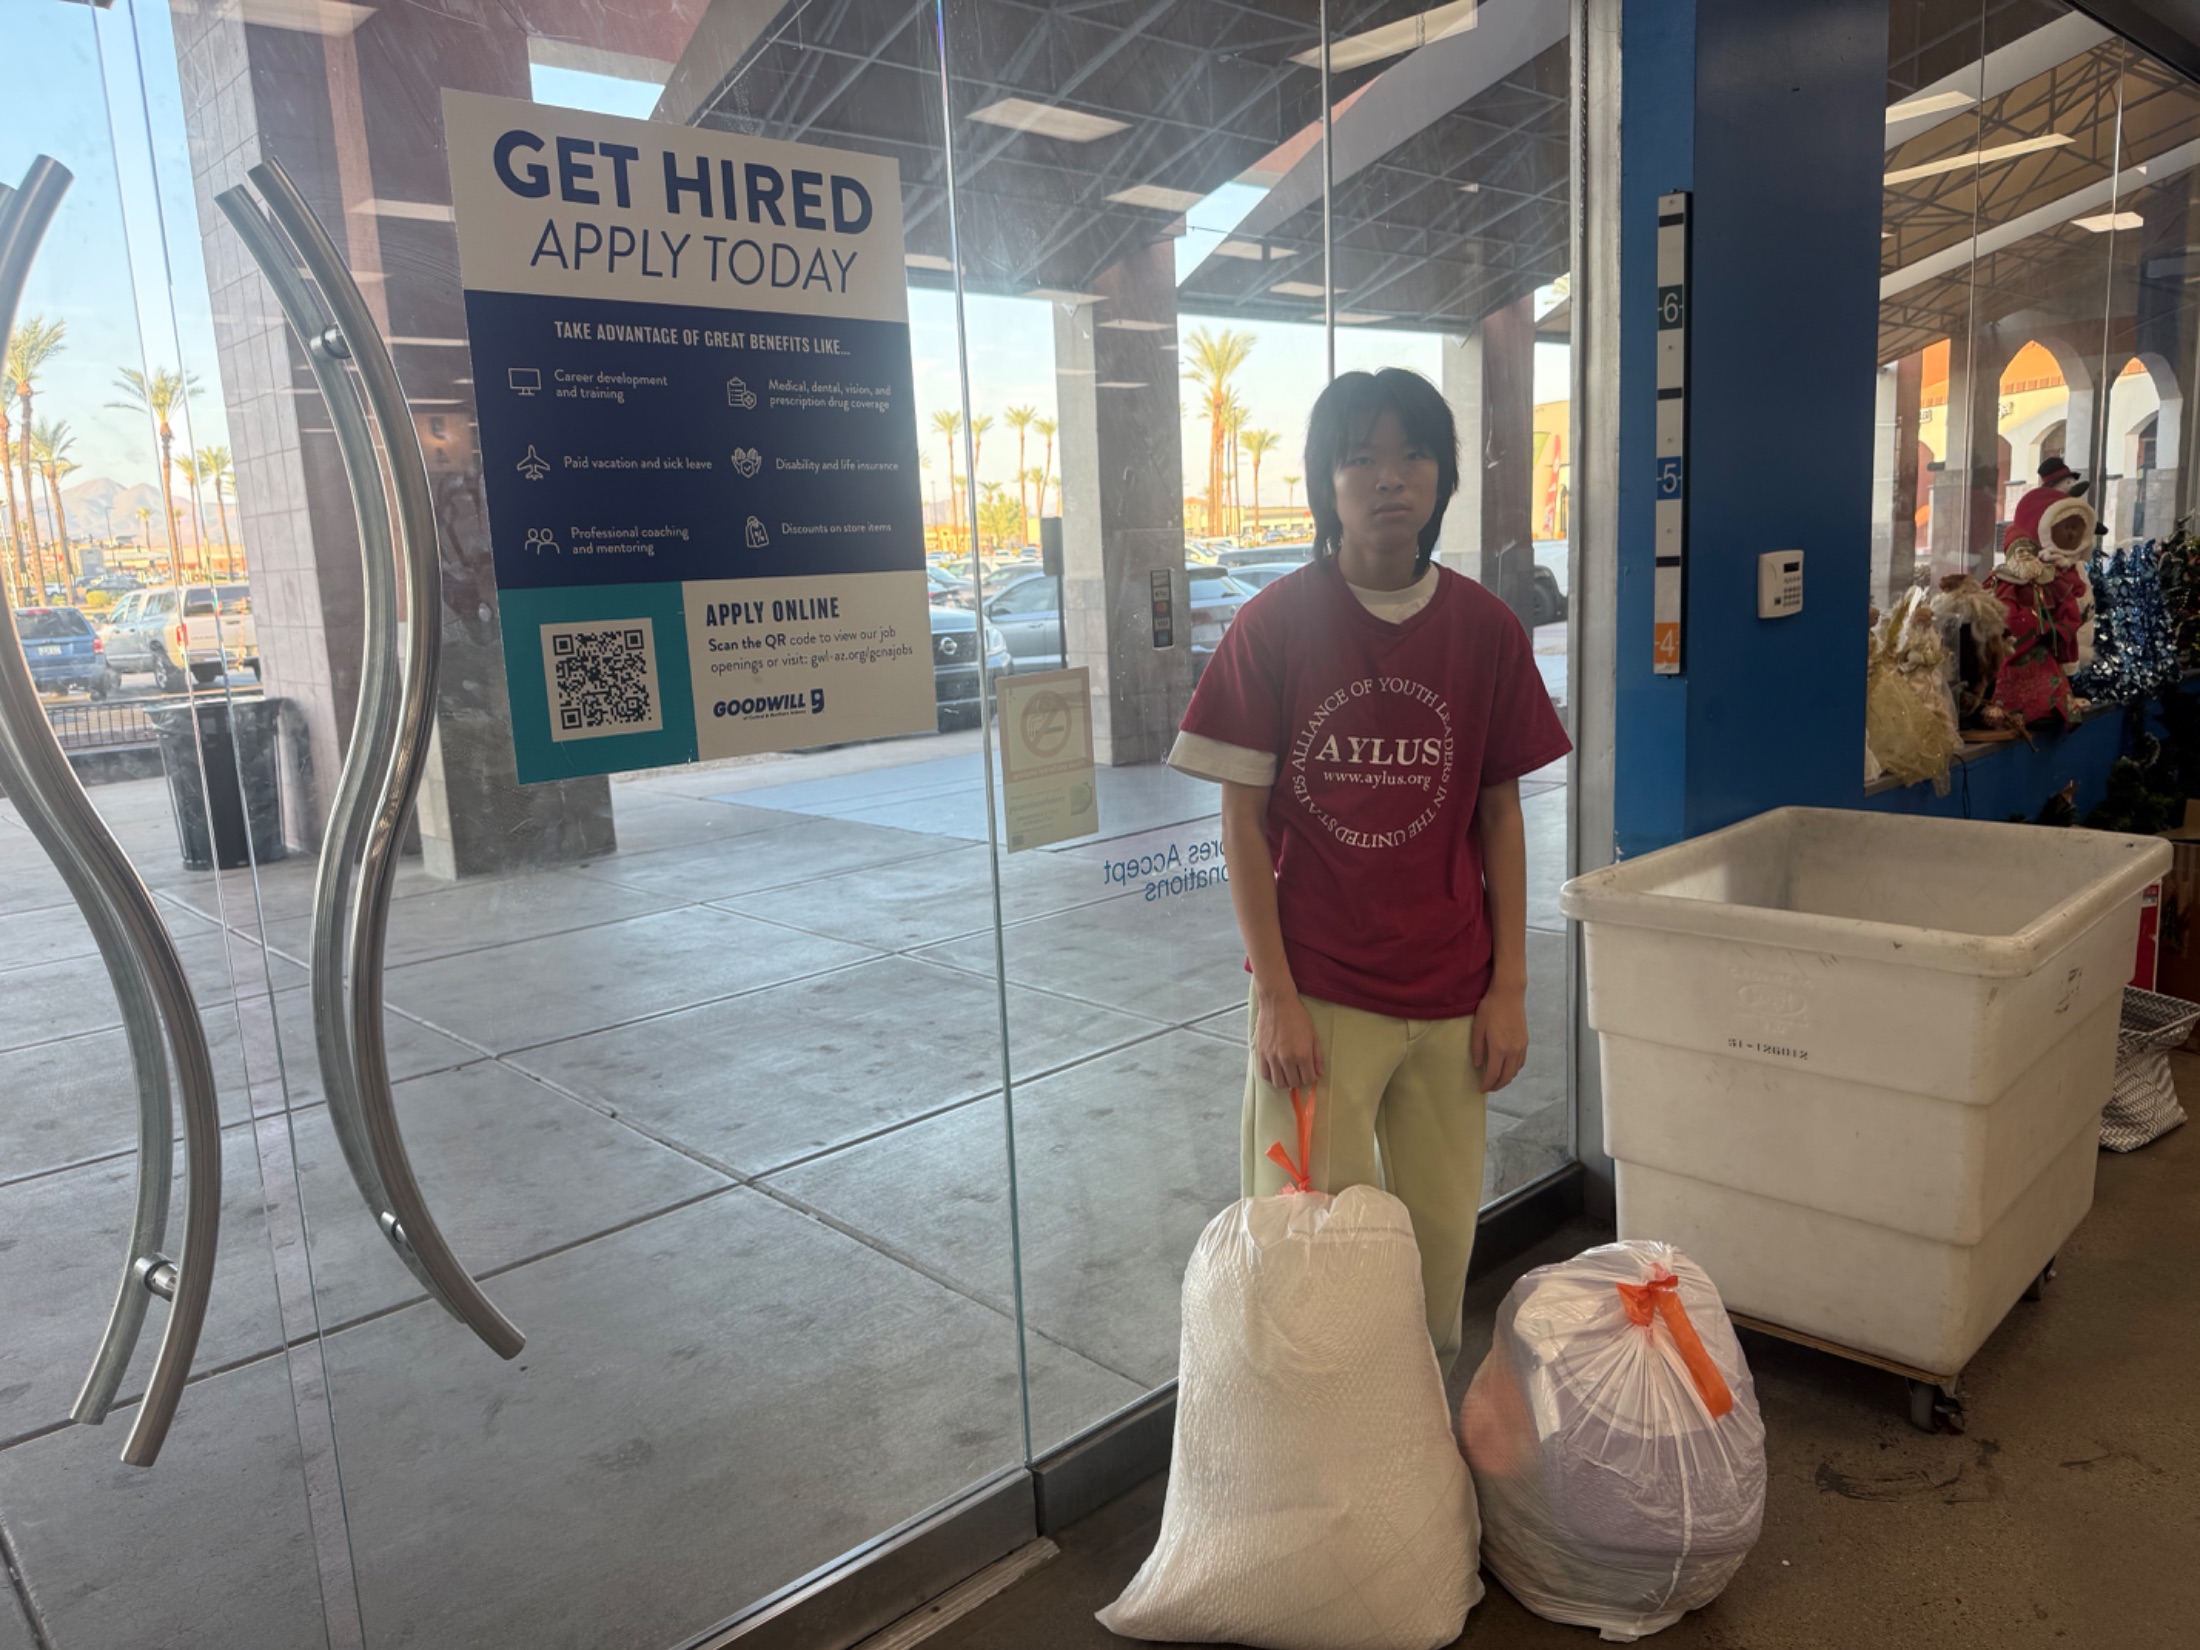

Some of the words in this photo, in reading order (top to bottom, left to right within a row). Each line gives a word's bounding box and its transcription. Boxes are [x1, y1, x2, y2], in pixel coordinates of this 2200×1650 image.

[493, 129, 639, 208] GET
[662, 150, 873, 235] HIRED
[530, 218, 691, 279] APPLY
[703, 235, 858, 293] TODAY
[1664, 292, 1679, 323] 6
[554, 320, 592, 340] TAKE
[597, 324, 678, 345] ADVANTAGE
[683, 329, 700, 346] OF
[704, 330, 746, 349] GREAT
[750, 333, 810, 352] BENEFITS
[814, 338, 851, 355] LIKE...
[553, 368, 594, 383] Career
[597, 370, 668, 389] development
[768, 378, 810, 395] Medical,
[811, 380, 844, 396] dental,
[845, 382, 873, 396] vision,
[874, 384, 892, 396] and
[555, 385, 577, 398] and
[580, 386, 625, 405] training
[769, 394, 826, 411] prescription
[828, 396, 850, 412] drug
[851, 400, 890, 413] coverage
[563, 455, 589, 469] Paid
[591, 456, 639, 469] vacation
[640, 456, 660, 469] and
[663, 456, 684, 470] sick
[686, 457, 713, 470] leave
[775, 457, 821, 475] Disability
[822, 459, 839, 471] and
[840, 458, 856, 471] life
[857, 460, 900, 471] insurance
[1662, 463, 1677, 494] 5
[570, 525, 639, 539] Professional
[641, 524, 690, 541] coaching
[781, 521, 828, 535] Discounts
[830, 524, 842, 534] on
[843, 523, 866, 534] store
[866, 521, 892, 533] items
[572, 541, 593, 555] and
[596, 540, 655, 557] mentoring
[706, 600, 764, 627] APPLY
[772, 596, 841, 623] ONLINE
[708, 637, 739, 653] Scan
[742, 636, 762, 650] the
[764, 632, 787, 650] QR
[789, 631, 817, 647] code
[819, 633, 831, 645] to
[834, 628, 858, 642] view
[860, 629, 877, 641] our
[879, 625, 896, 644] job
[1660, 629, 1675, 658] 4
[711, 657, 764, 677] openings
[766, 658, 778, 669] or
[781, 652, 809, 666] visit:
[1350, 678, 1374, 697] OF
[1378, 677, 1440, 708] YOUTH
[713, 693, 807, 718] GOODWILL
[1291, 688, 1350, 772] ALLIANCE
[1434, 701, 1454, 784] LEADERS
[1315, 734, 1443, 767] AYLUS
[1323, 770, 1431, 792] www.aylus.org
[1291, 775, 1339, 833] STATES
[1433, 785, 1448, 809] IN
[1408, 807, 1437, 839] THE
[1335, 826, 1407, 849] UNITED
